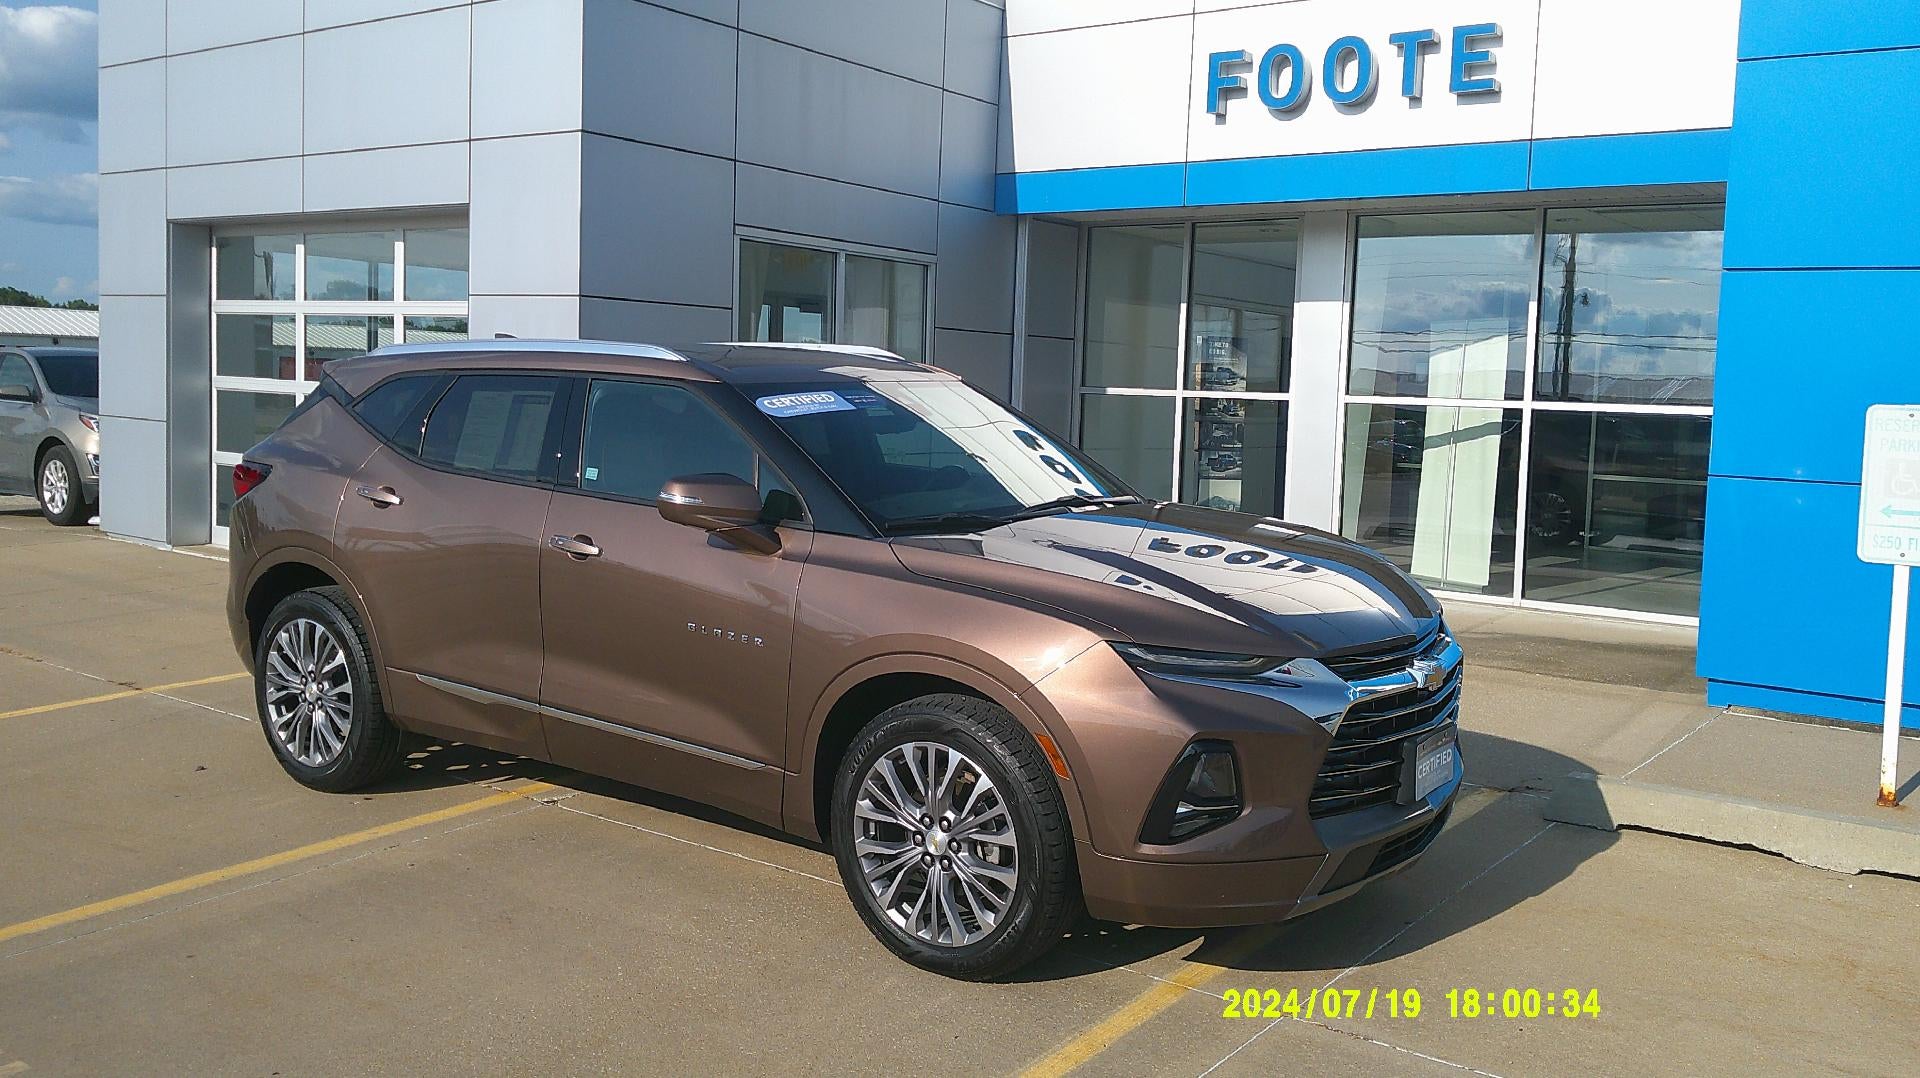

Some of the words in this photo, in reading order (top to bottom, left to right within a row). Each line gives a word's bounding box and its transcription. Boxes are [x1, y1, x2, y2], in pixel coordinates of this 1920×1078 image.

[1206, 22, 1502, 118] FOOTE
[763, 393, 835, 409] CERTIFIED
[1872, 533, 1902, 551] $250
[687, 622, 764, 647] BLAZER
[1417, 748, 1453, 779] CERTIFIED
